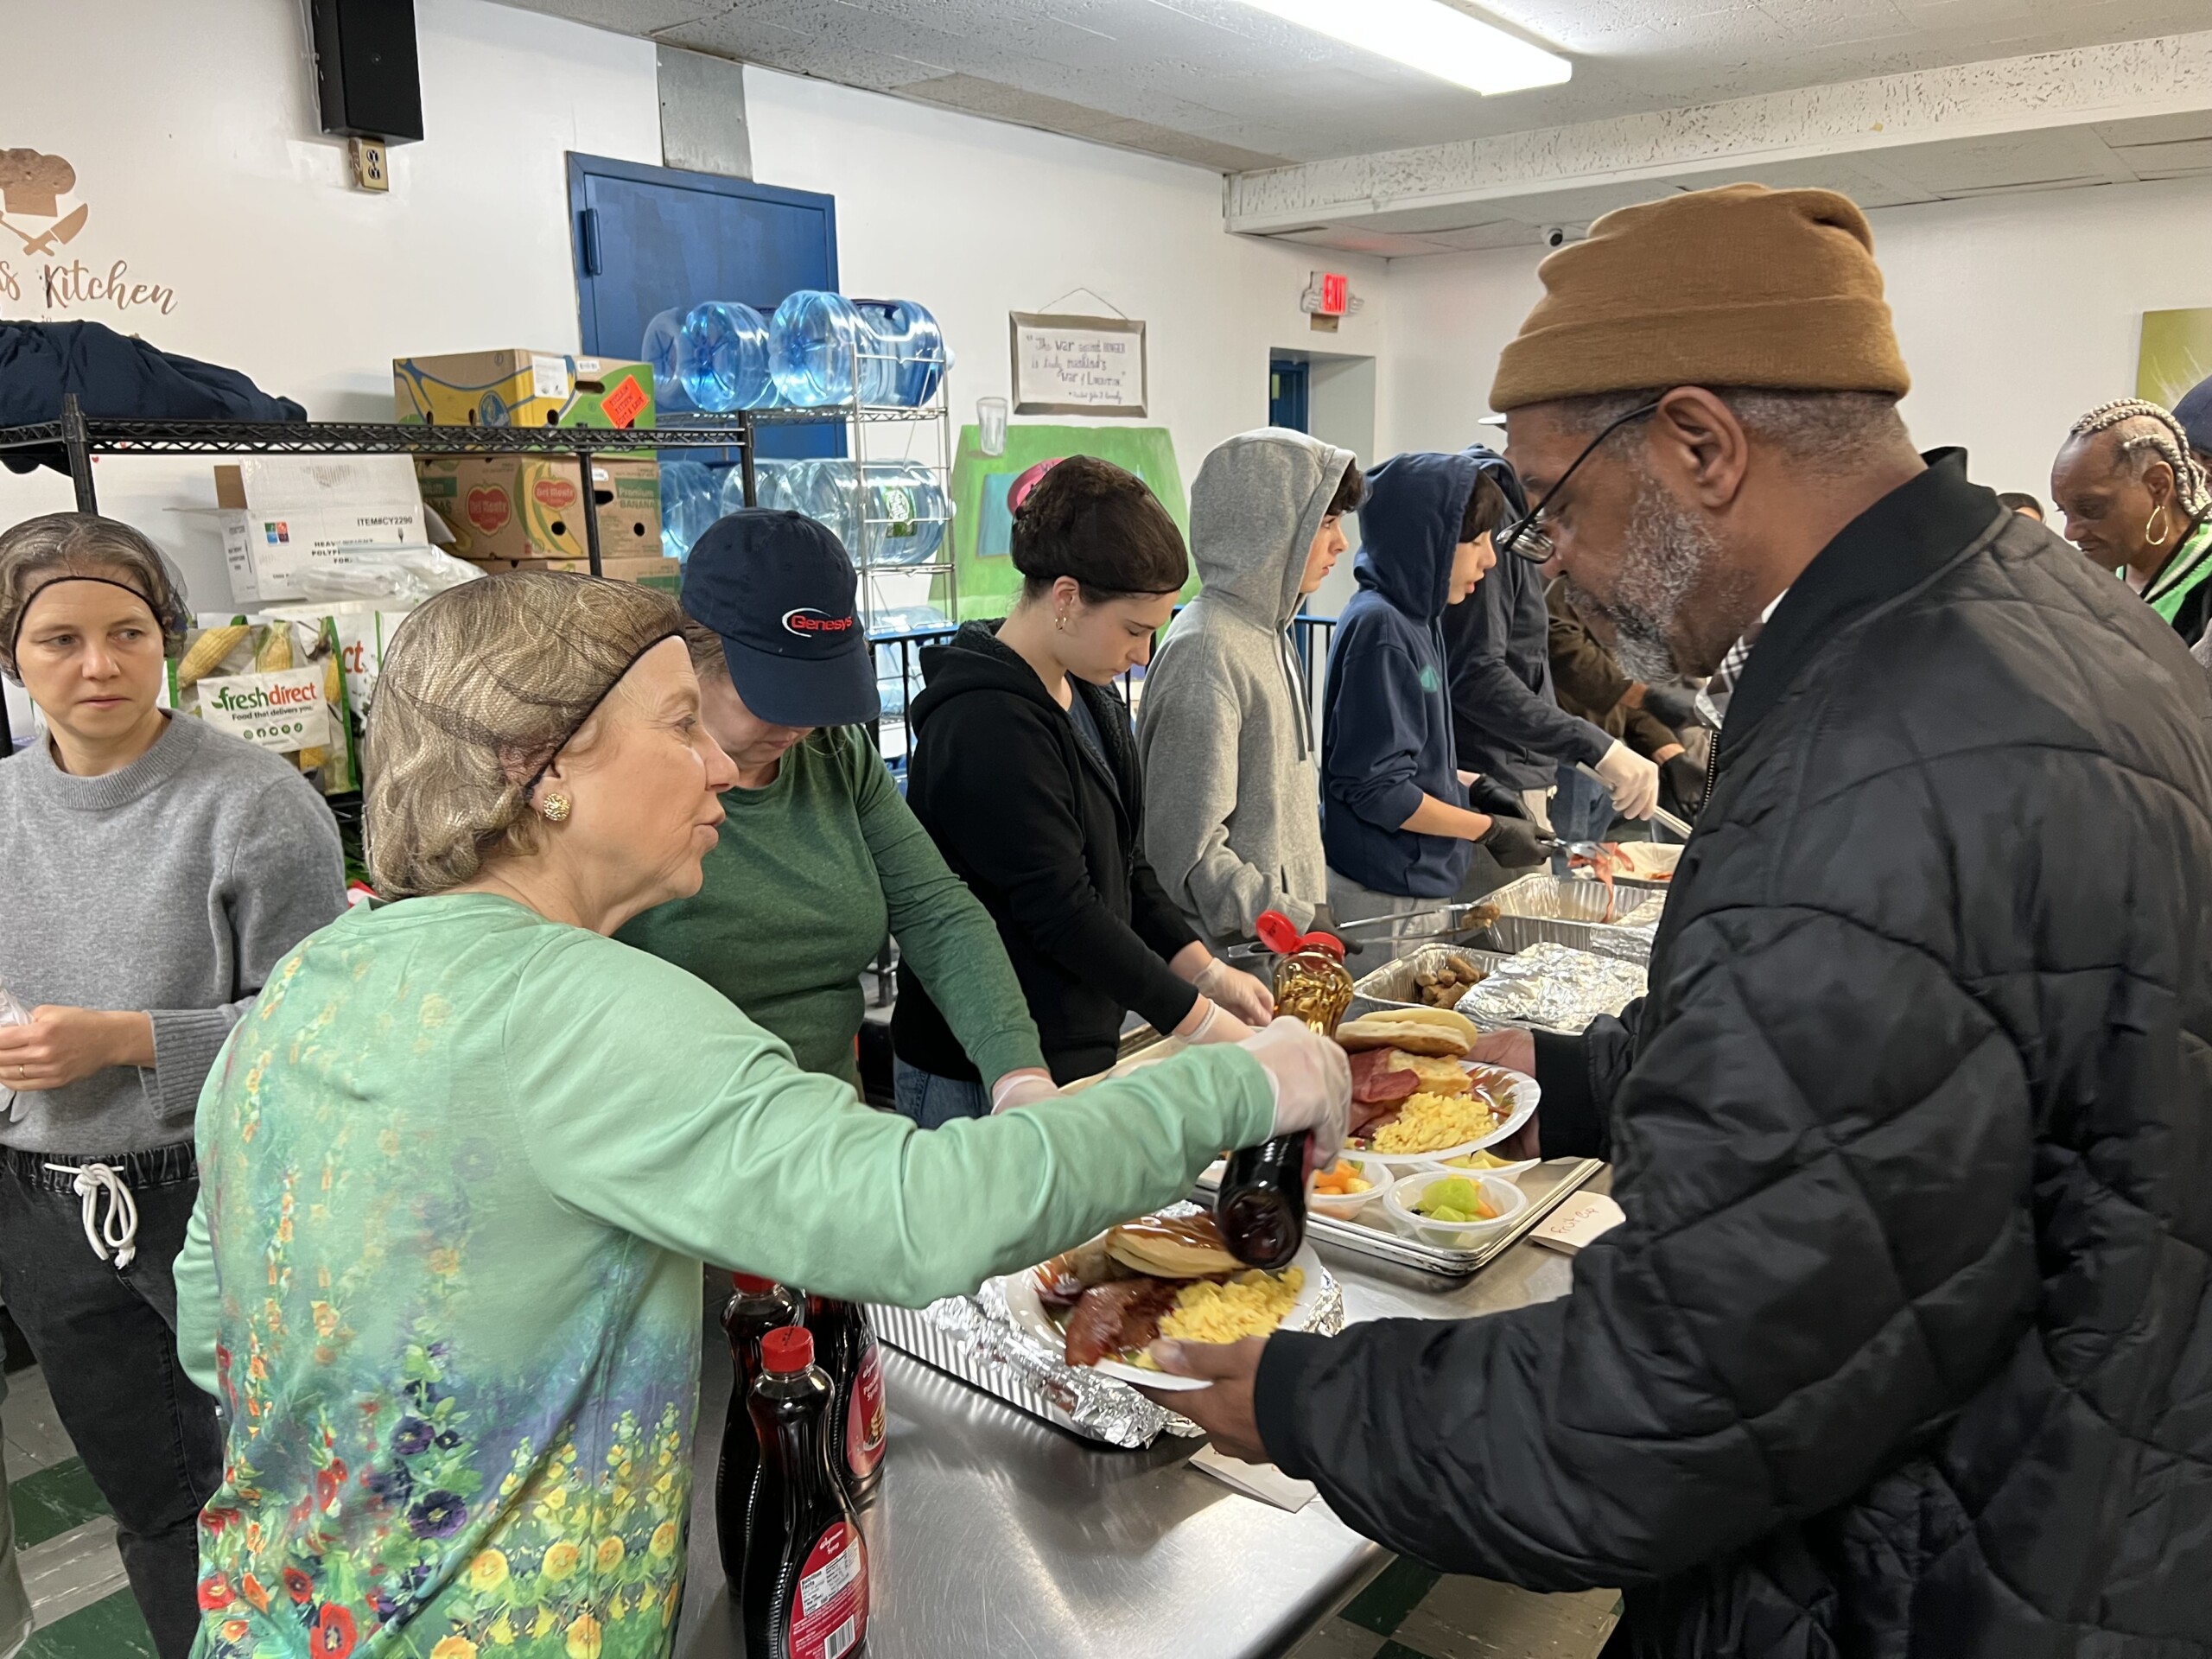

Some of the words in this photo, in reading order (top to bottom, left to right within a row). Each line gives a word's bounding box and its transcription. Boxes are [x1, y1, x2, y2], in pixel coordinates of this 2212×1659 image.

[44, 259, 178, 315] Kitchen
[1323, 274, 1346, 314] EXIT
[791, 615, 853, 632] Genesys
[212, 682, 317, 711] freshdirect
[232, 713, 252, 721] Food
[254, 710, 270, 719] that
[270, 706, 298, 718] delivers
